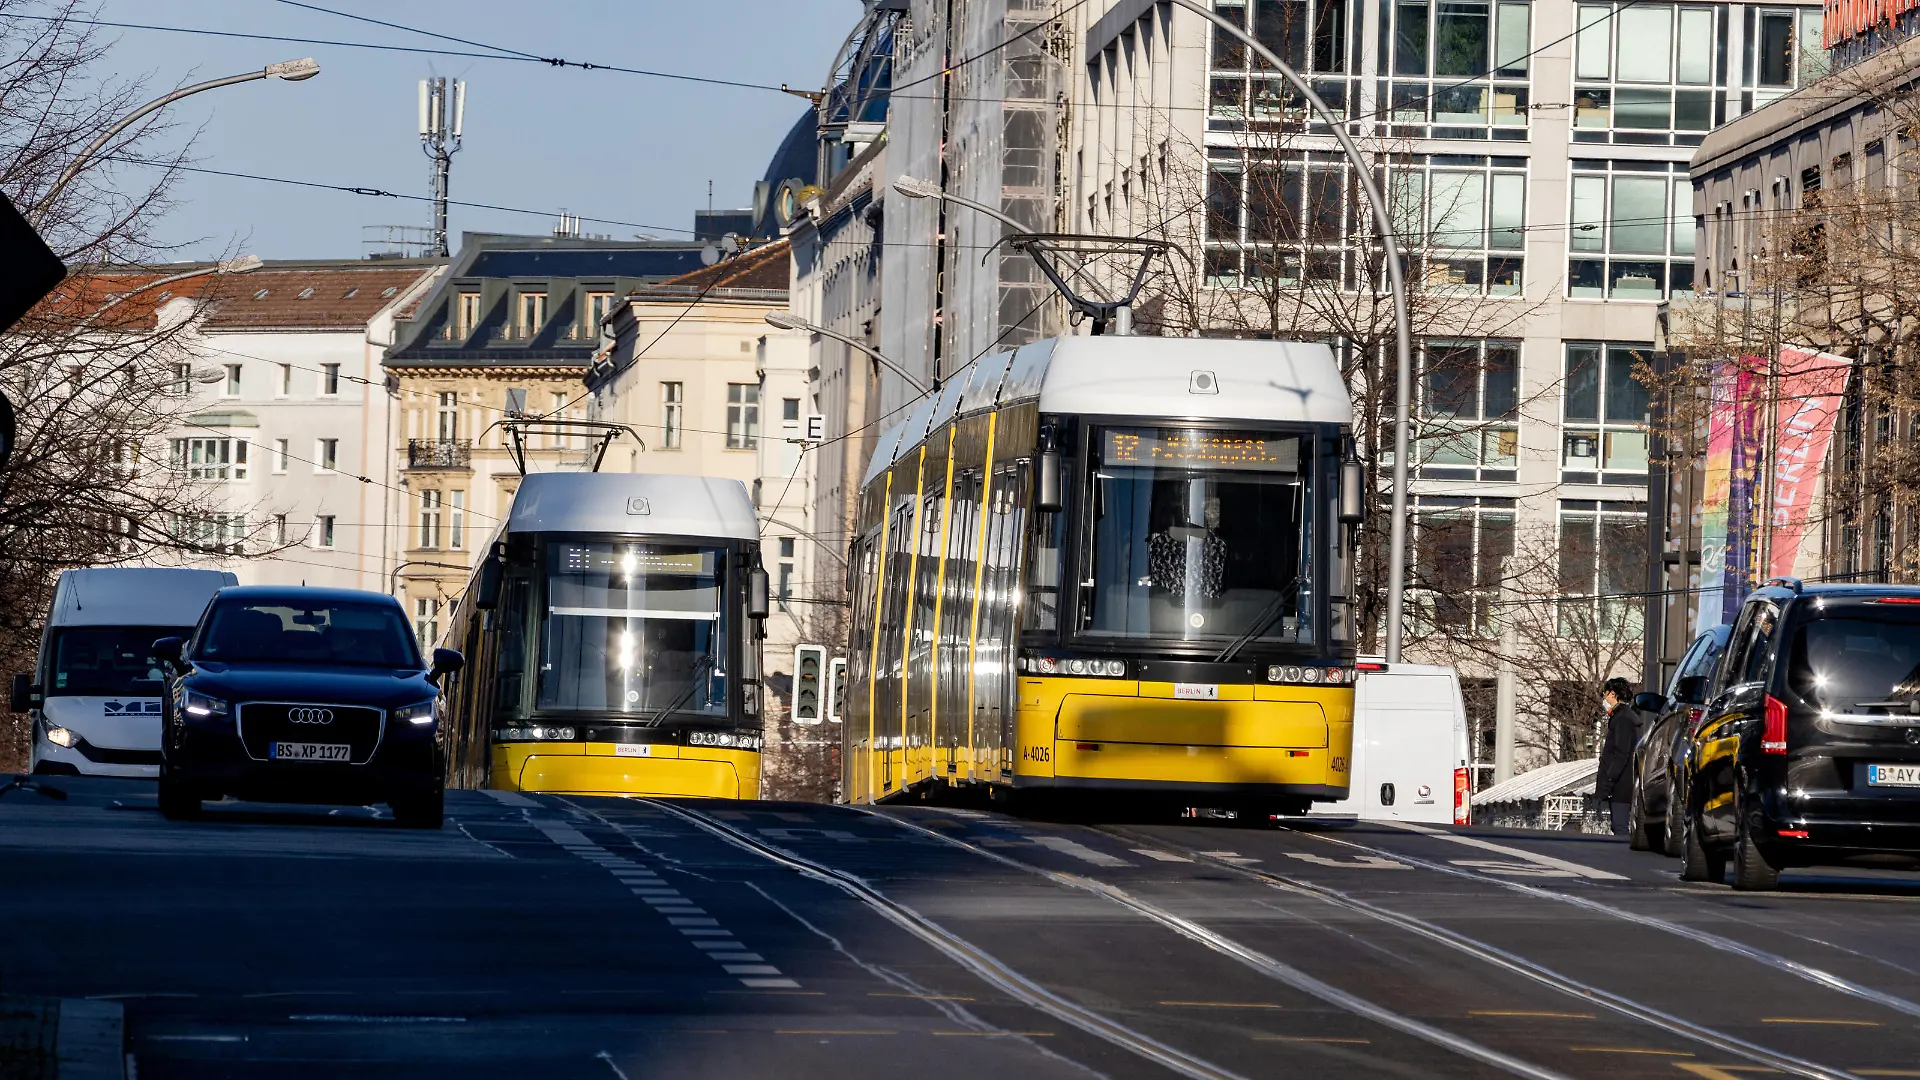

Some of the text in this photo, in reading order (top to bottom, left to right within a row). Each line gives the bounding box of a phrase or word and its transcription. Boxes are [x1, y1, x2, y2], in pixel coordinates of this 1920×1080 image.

[808, 417, 822, 438] E
[1772, 395, 1824, 528] BERLIN
[278, 744, 349, 759] BS XP 1177
[1878, 768, 1887, 780] B
[1896, 769, 1914, 781] AY
